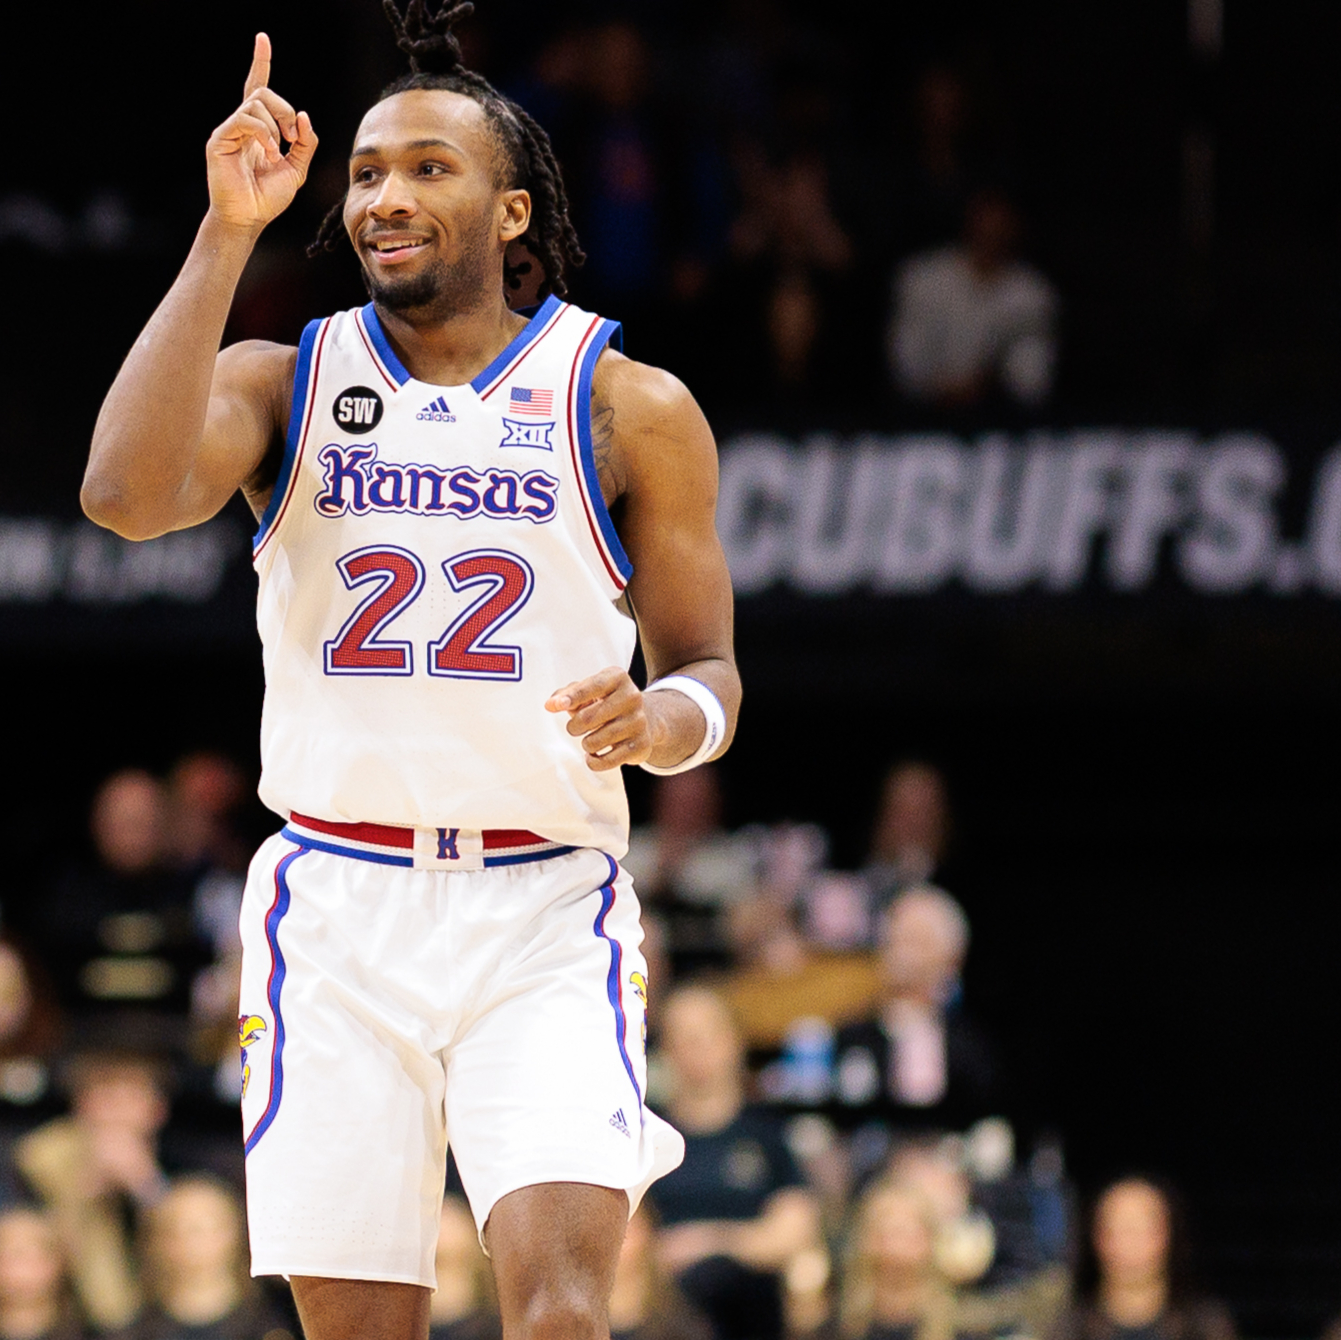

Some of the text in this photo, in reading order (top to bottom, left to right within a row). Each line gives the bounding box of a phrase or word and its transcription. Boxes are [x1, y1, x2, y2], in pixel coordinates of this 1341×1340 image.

[338, 397, 377, 424] SW
[416, 411, 456, 423] adidas
[315, 443, 560, 523] Kansas
[324, 545, 535, 682] 22
[436, 828, 460, 859] K
